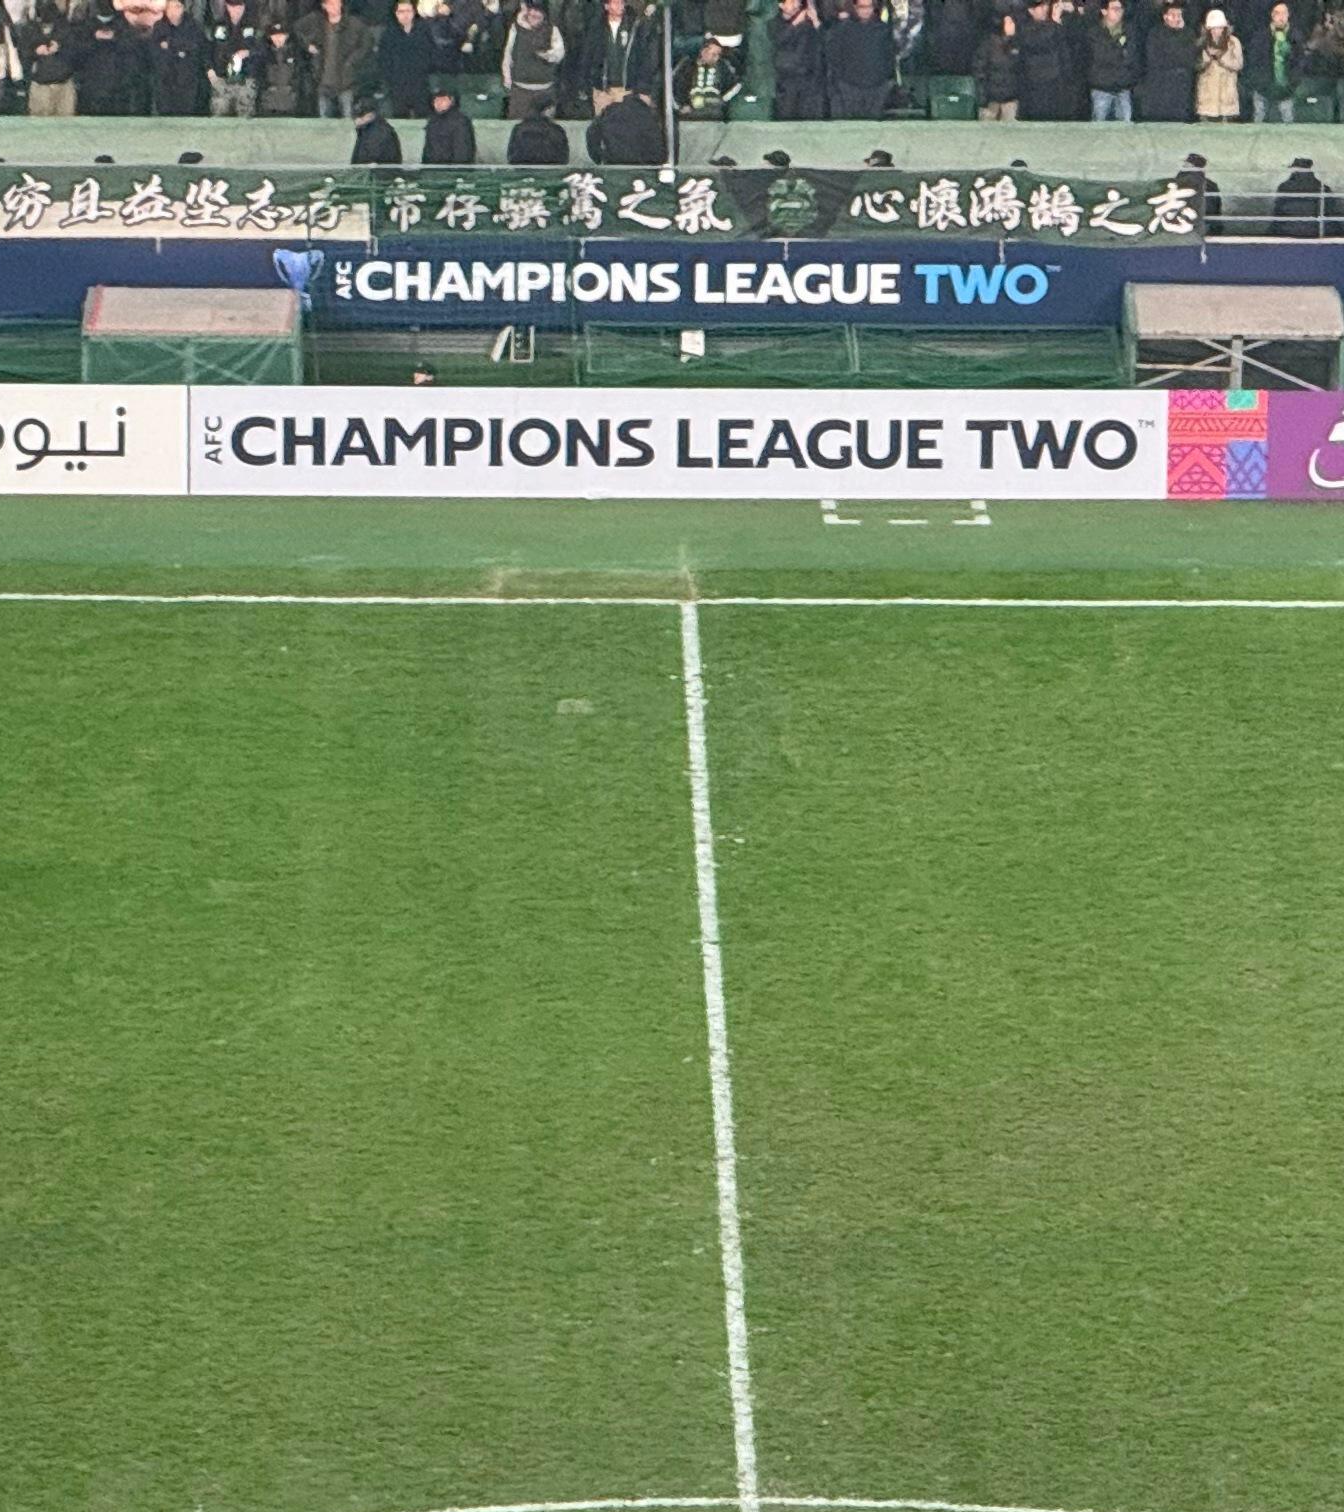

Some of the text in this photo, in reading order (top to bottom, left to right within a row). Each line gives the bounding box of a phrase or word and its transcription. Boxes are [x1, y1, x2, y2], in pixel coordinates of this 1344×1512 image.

[849, 175, 1198, 236] 心懷鴻鵠之志
[334, 260, 353, 300] AFC
[354, 260, 1050, 306] CHAMPIONS LEAGUE TWO
[204, 415, 224, 465] AFC
[230, 415, 656, 467] CHAMPIONS
[676, 418, 944, 469] LEAGUE
[965, 418, 1139, 470] TWO
